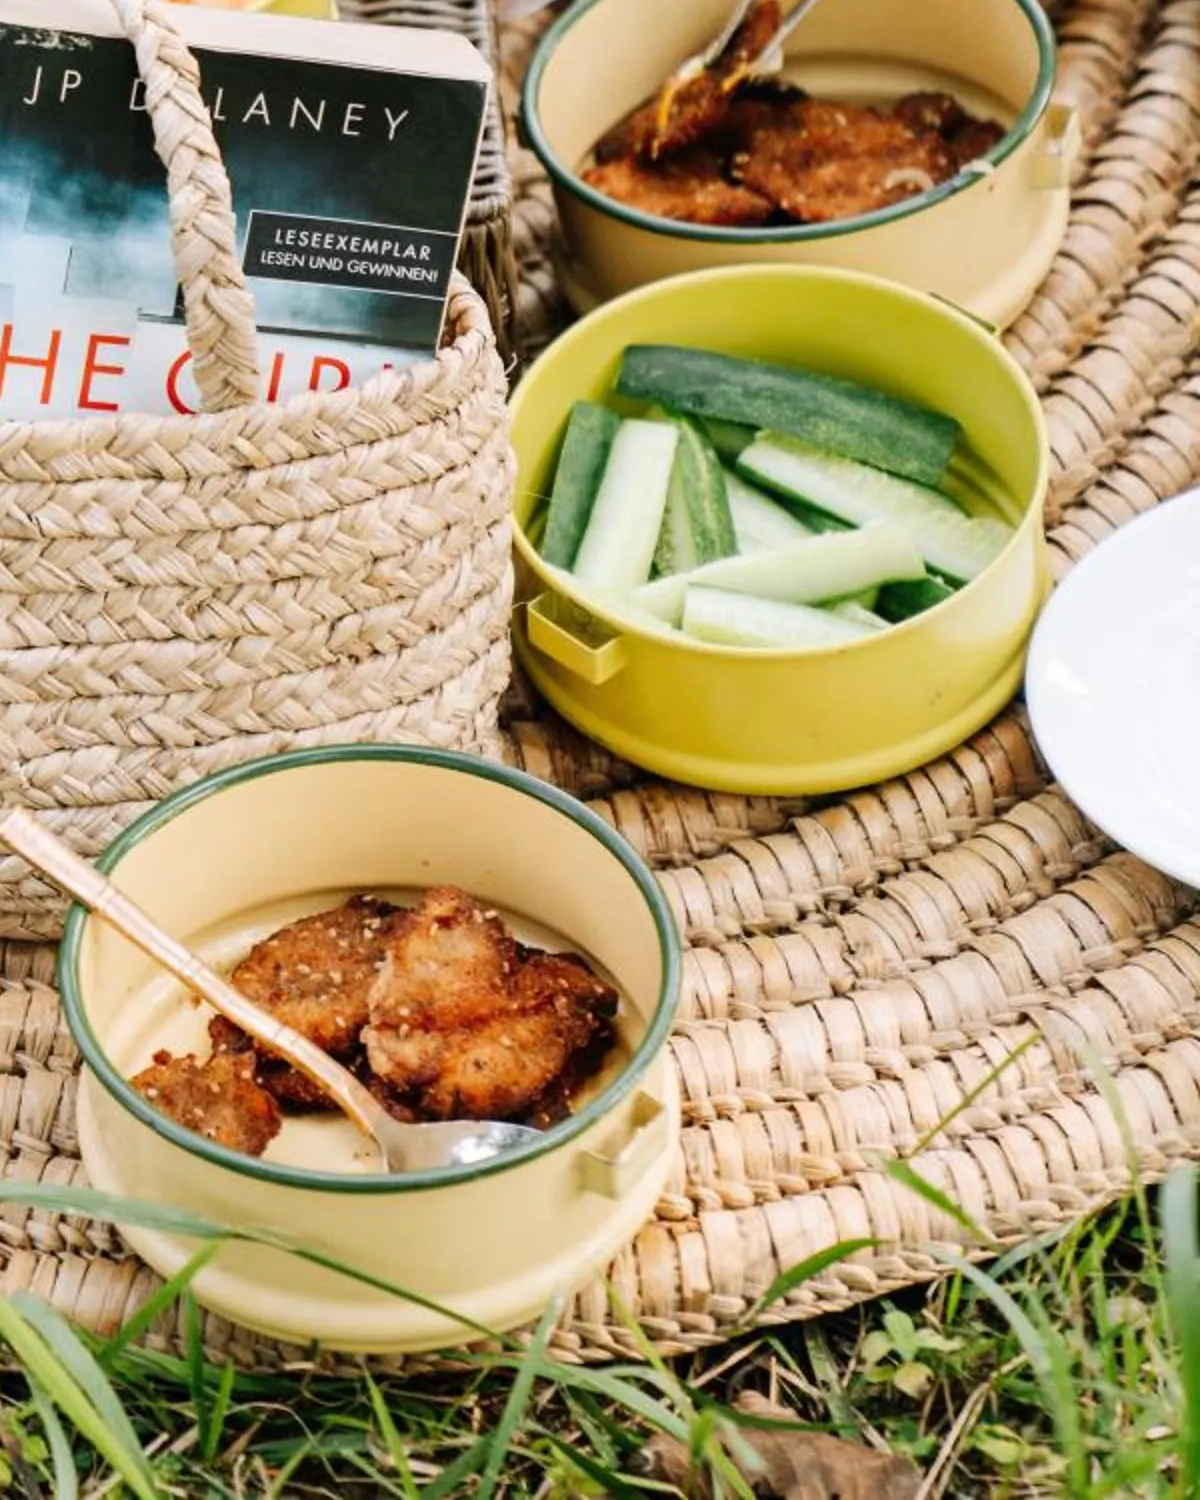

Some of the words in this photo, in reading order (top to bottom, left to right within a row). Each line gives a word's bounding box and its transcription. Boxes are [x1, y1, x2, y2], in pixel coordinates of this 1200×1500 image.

[23, 65, 82, 105] JP
[129, 78, 409, 141] DLANEY
[275, 228, 432, 261] LESEEXEMPLAR
[260, 250, 305, 268] LESEN
[309, 255, 343, 272] UND
[347, 259, 439, 283] GEWINNEN!
